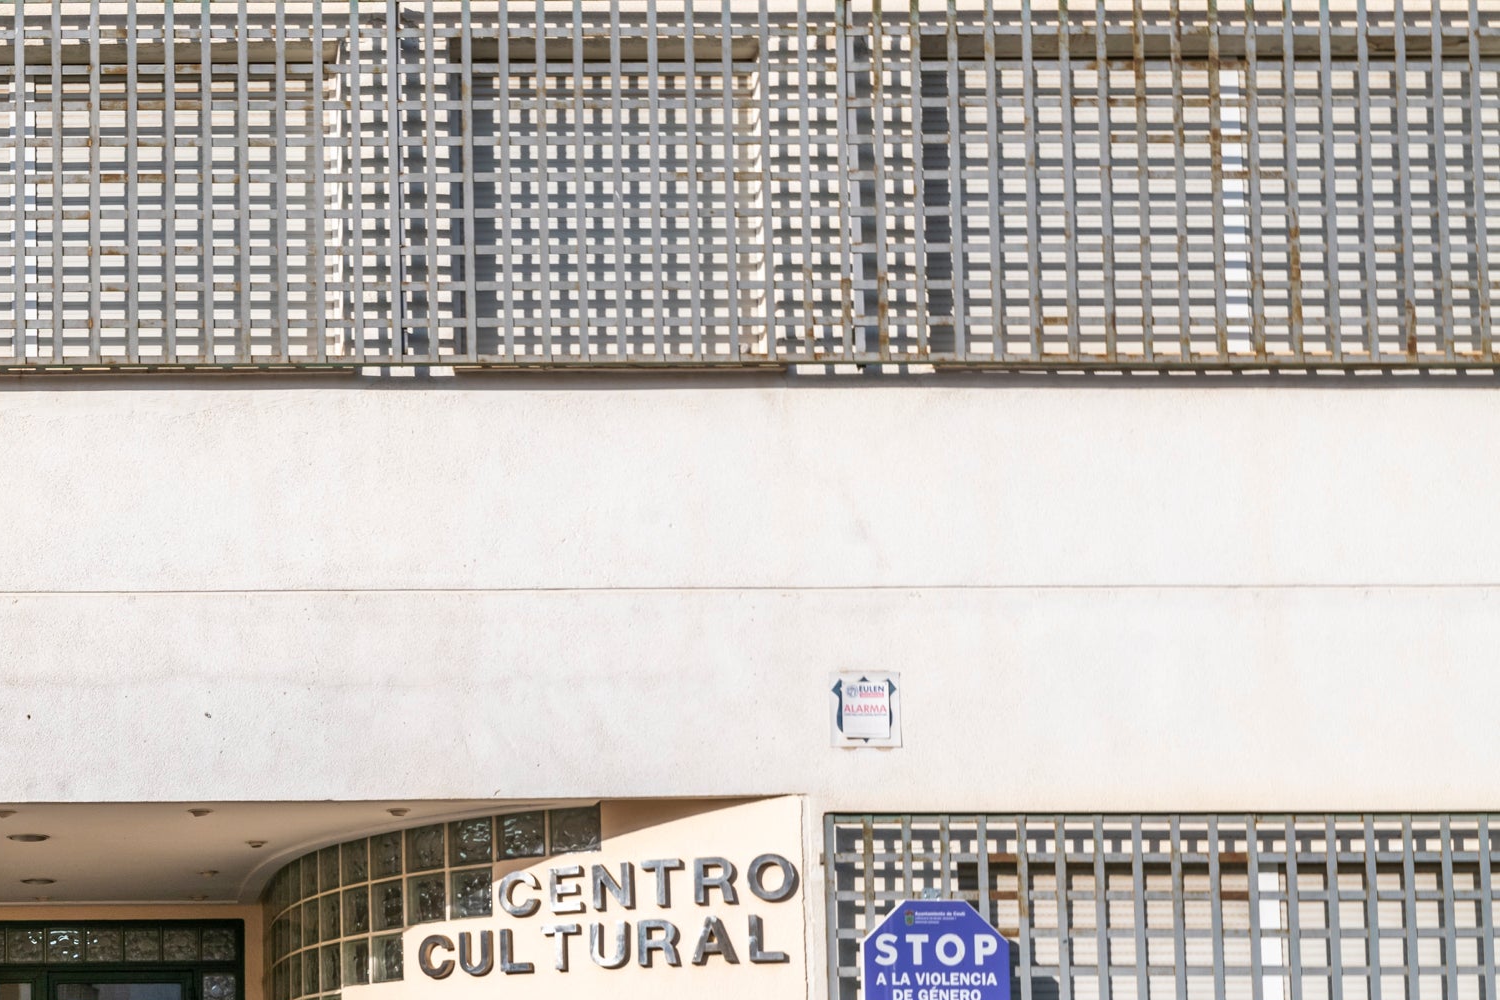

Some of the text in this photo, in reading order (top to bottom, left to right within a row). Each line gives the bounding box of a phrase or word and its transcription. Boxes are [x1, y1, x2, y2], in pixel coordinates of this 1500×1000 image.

[859, 685, 884, 693] EULEN
[844, 704, 887, 713] ALARMA
[498, 853, 800, 918] CENTRO
[417, 913, 790, 980] CULTURAL
[874, 932, 998, 967] STOP
[876, 971, 998, 986] A LA VIOLENCIA
